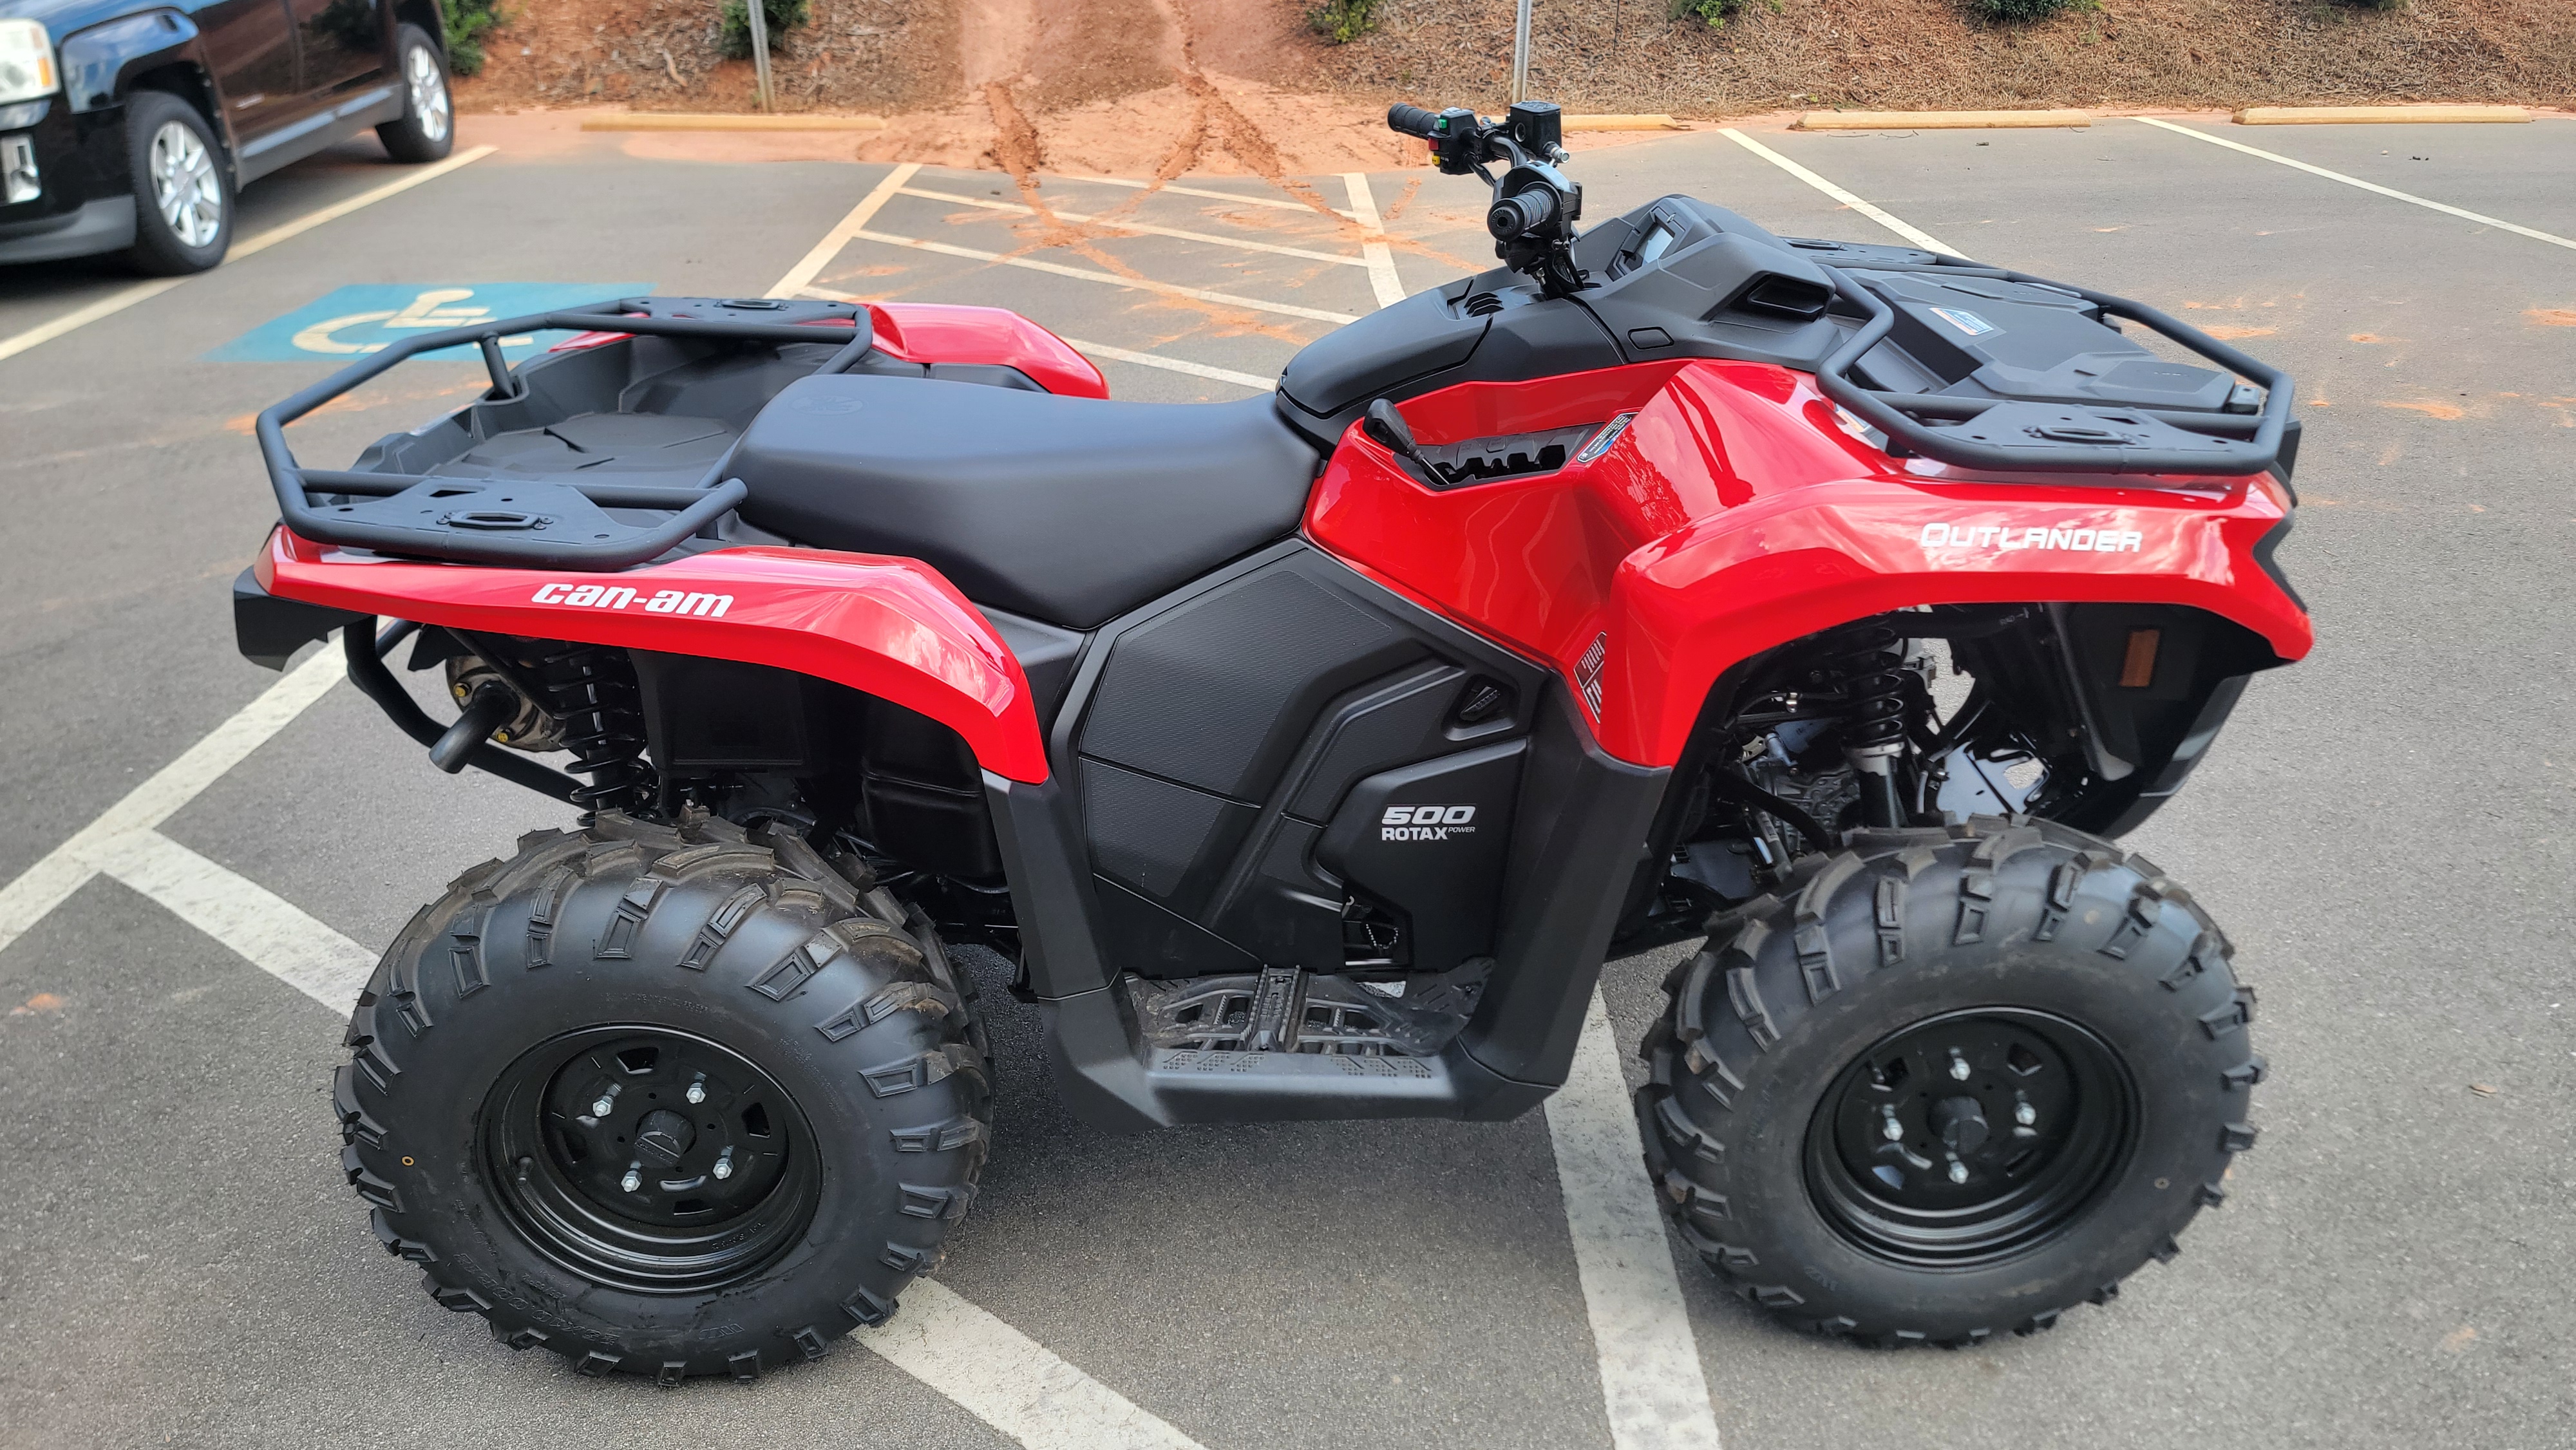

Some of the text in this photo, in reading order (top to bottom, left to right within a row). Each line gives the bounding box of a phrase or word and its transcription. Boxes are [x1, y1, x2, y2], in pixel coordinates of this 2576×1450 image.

[1920, 522, 2143, 553] OUTLANDER
[531, 583, 734, 618] can-am
[1381, 806, 1476, 825] 500
[1381, 827, 1448, 841] ROTAX
